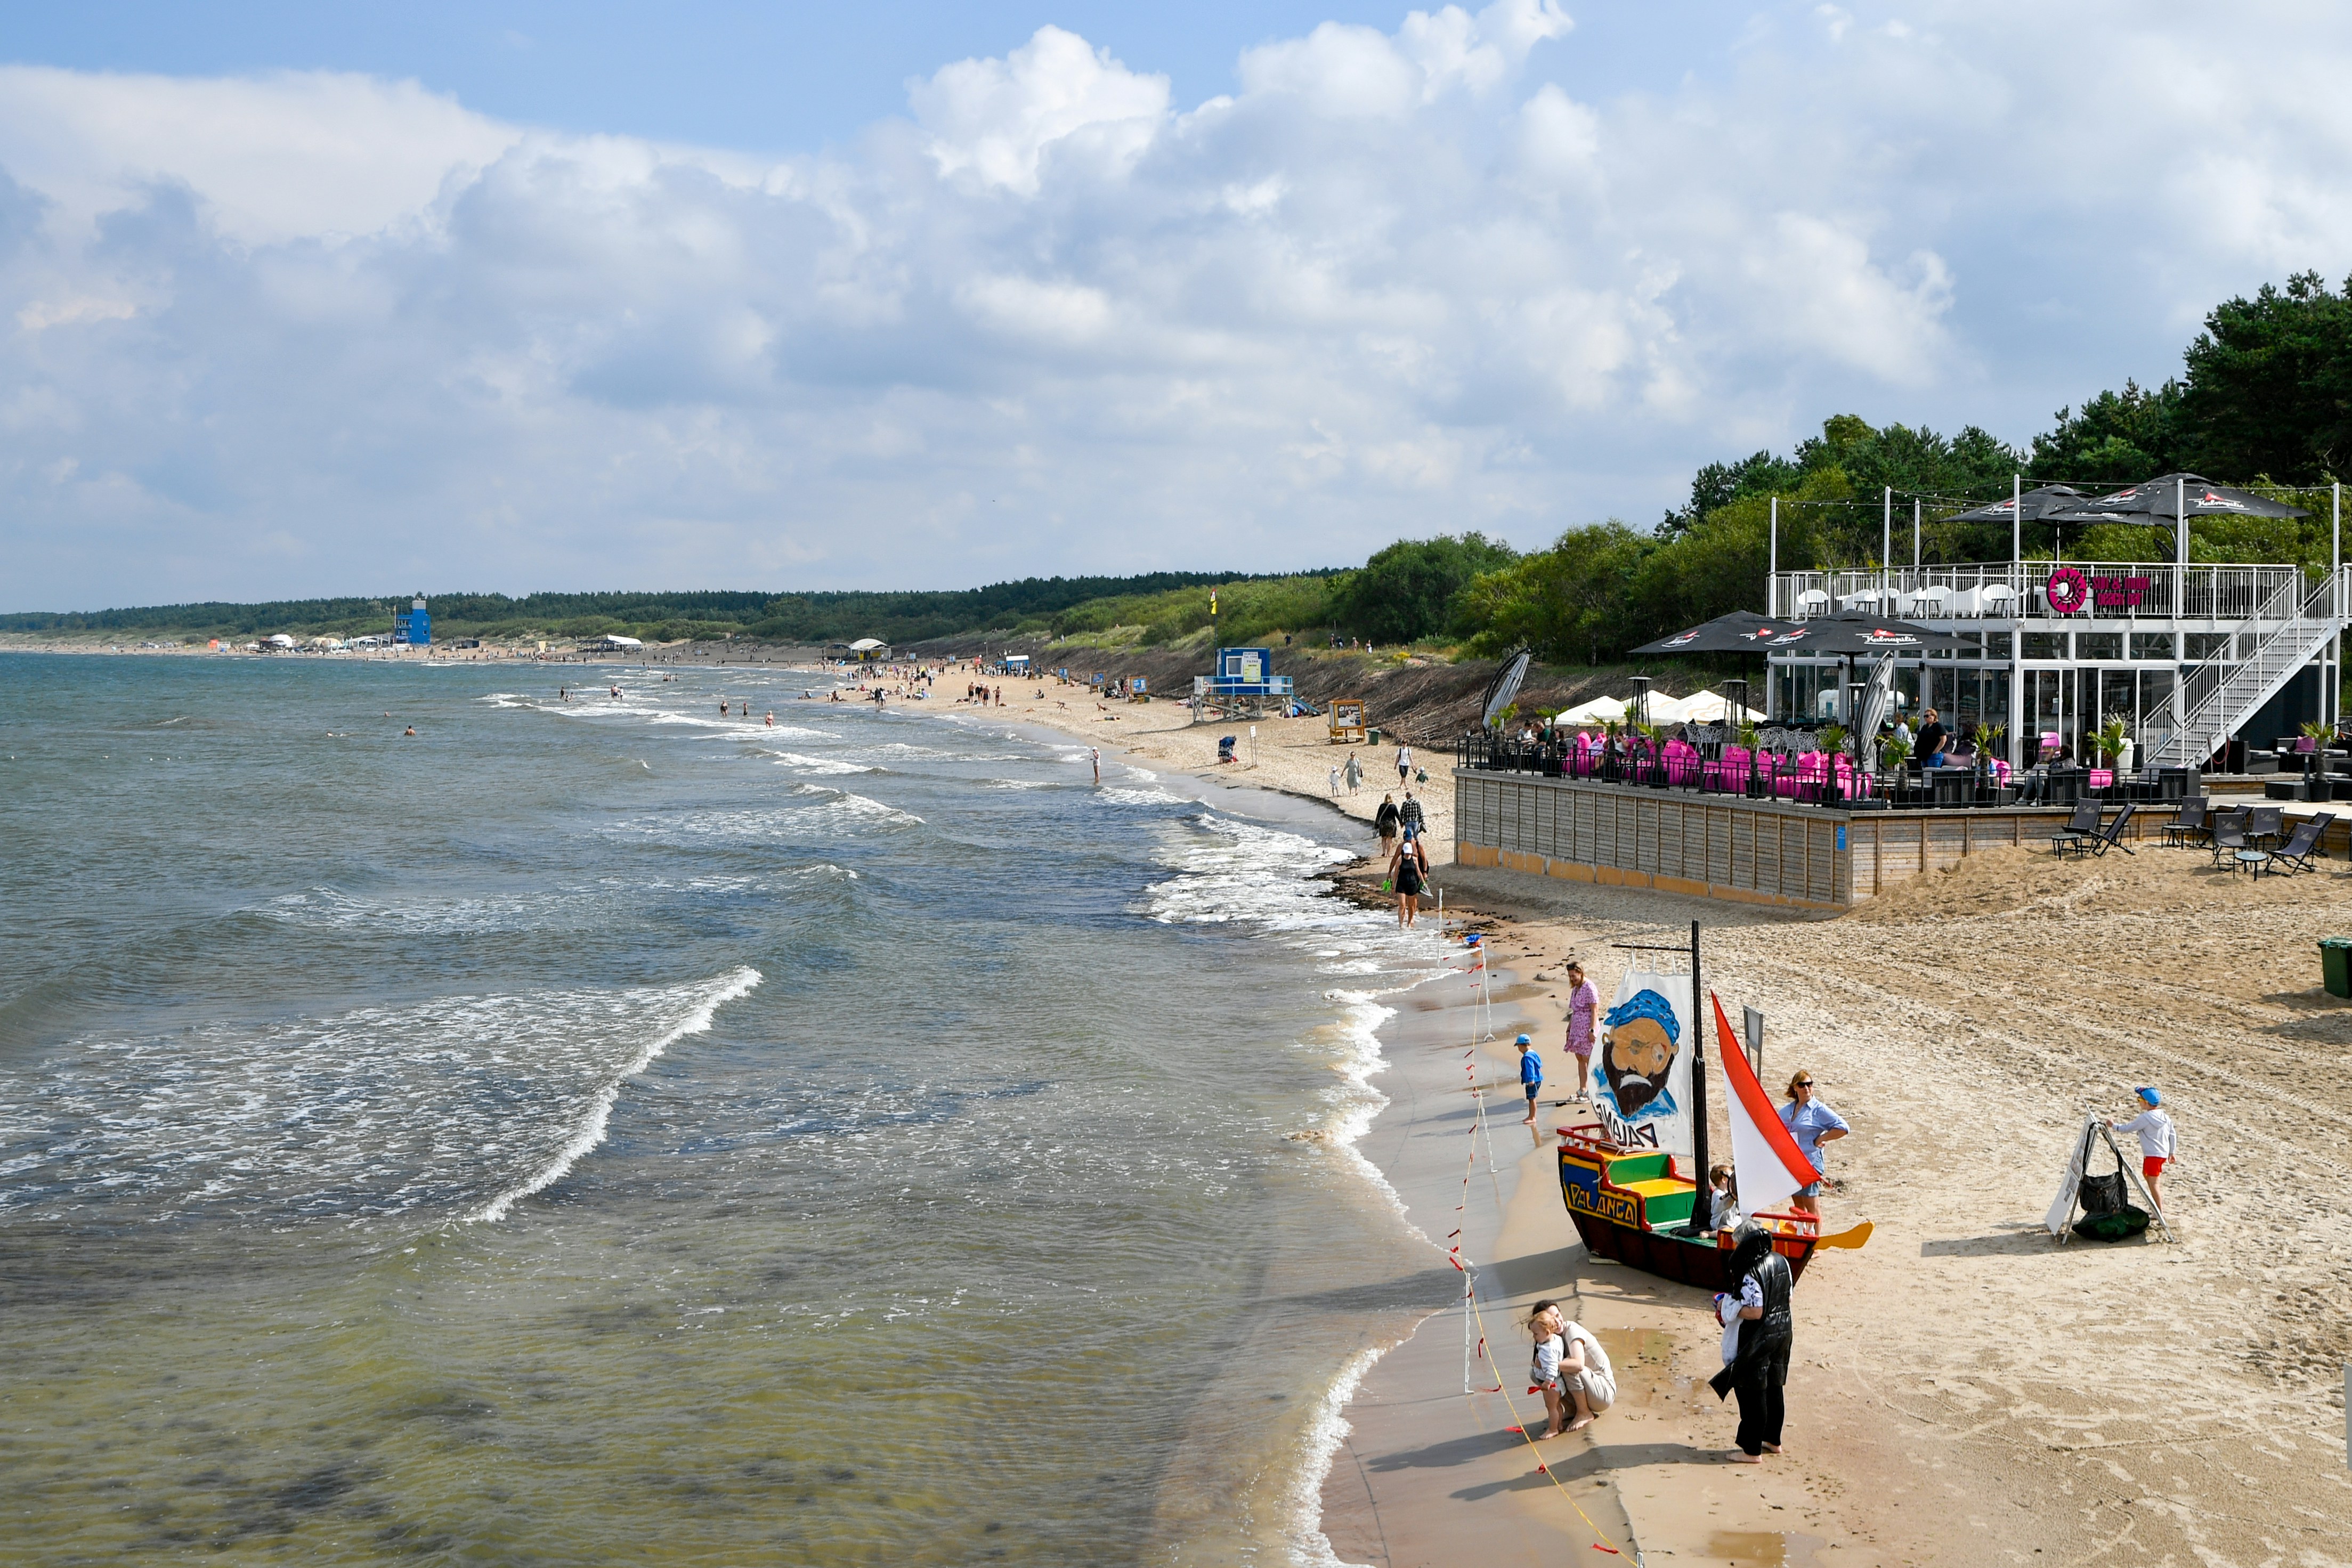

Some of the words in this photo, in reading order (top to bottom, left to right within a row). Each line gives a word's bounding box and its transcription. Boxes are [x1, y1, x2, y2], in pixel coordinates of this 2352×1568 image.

[2111, 577, 2121, 590] &
[1862, 635, 1917, 644] Kalnapilis
[1570, 1183, 1634, 1223] PALANGA
